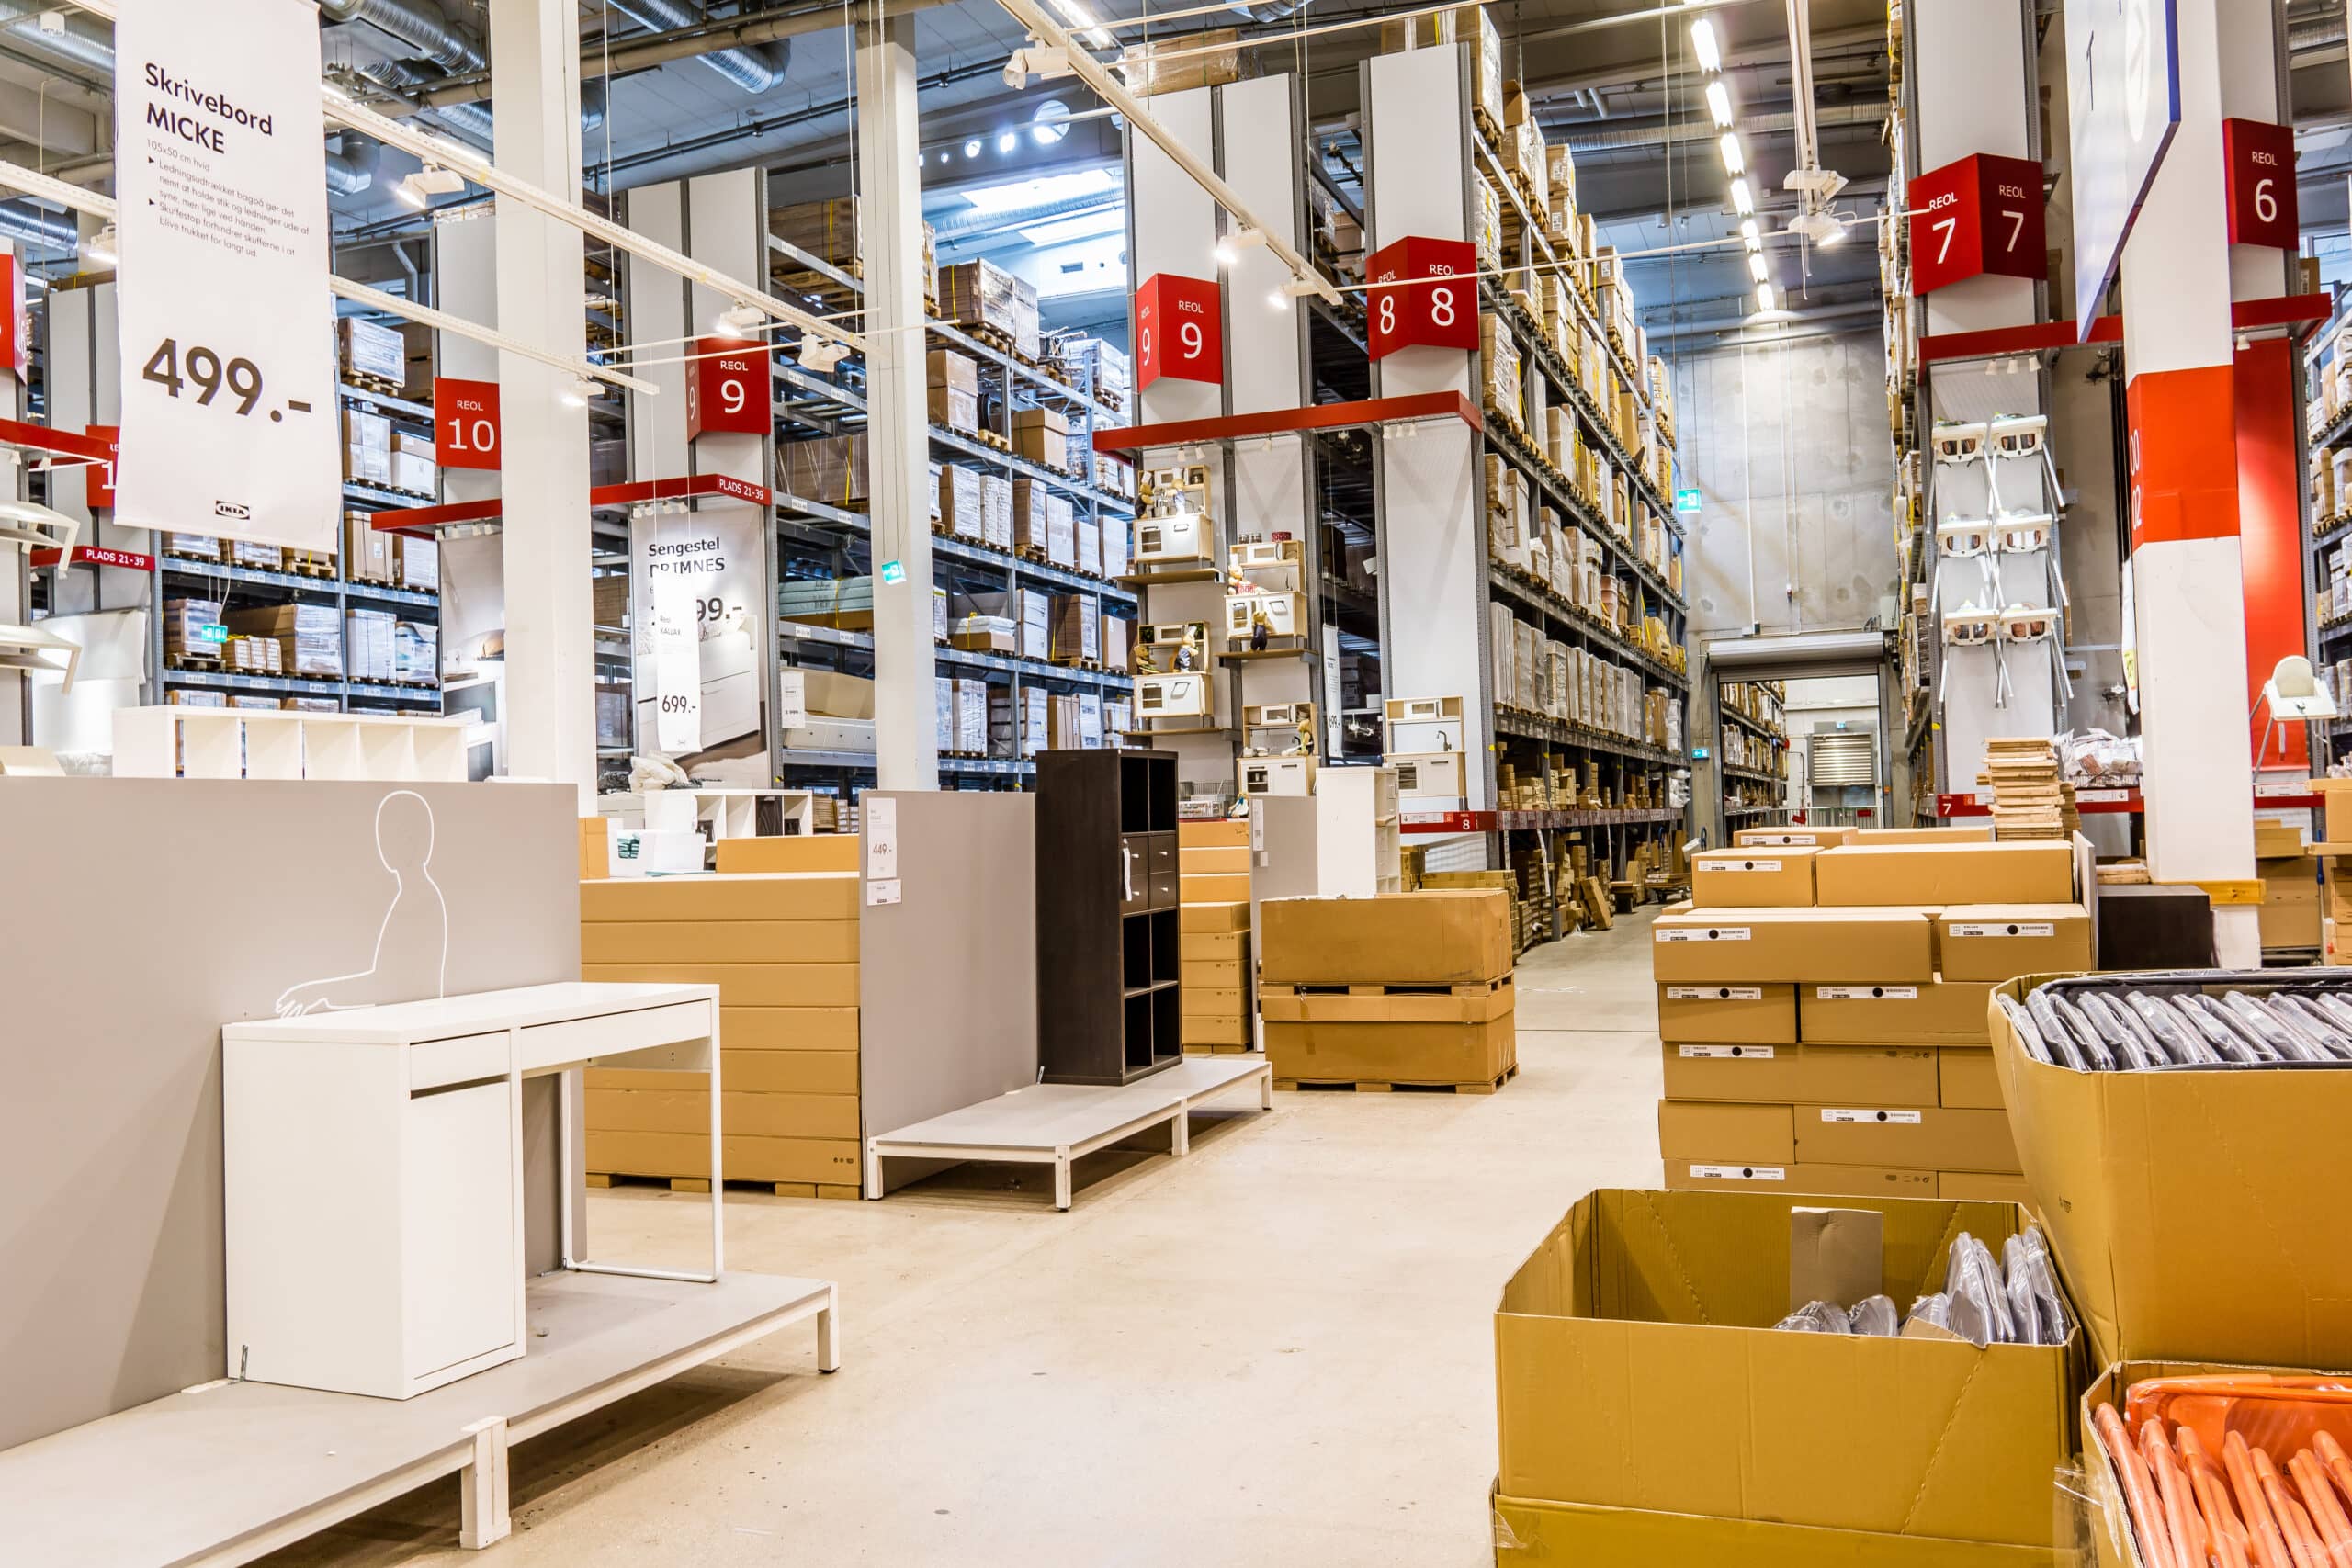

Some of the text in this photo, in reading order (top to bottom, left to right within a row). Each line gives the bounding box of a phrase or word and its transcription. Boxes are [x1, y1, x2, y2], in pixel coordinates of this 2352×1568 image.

[145, 62, 273, 136] Skrivebord
[146, 102, 225, 154] MICKE
[147, 138, 210, 172] 105x50 cm hvid
[2252, 151, 2278, 166] REOL
[159, 175, 179, 189] nemt
[191, 186, 215, 201] holde
[216, 197, 230, 208] stik
[231, 204, 243, 214] og
[243, 205, 281, 226] ledninger
[283, 221, 300, 231] ude
[1929, 191, 1958, 211] REOL
[1998, 184, 2027, 199] REOL
[2255, 178, 2278, 223] 6
[182, 198, 199, 209] men
[201, 205, 217, 217] lige
[219, 212, 233, 222] ved
[281, 208, 295, 218] det
[159, 215, 179, 231] blive
[181, 224, 209, 241] trukket
[1932, 217, 1956, 265] 7
[2002, 210, 2024, 253] 7
[1178, 300, 1204, 314] REOL
[1380, 295, 1396, 335] 8
[1431, 287, 1455, 327] 8
[1142, 327, 1150, 367] 9
[1180, 321, 1203, 359] 9
[720, 360, 749, 371] REOL
[142, 337, 312, 423] 499.-
[457, 400, 484, 412] REOL
[689, 386, 695, 421] 9
[720, 379, 745, 414] 9
[448, 418, 495, 452] 10
[101, 460, 116, 490] 1
[719, 479, 764, 500] PLADS 21-39
[218, 502, 247, 517] IKEA
[86, 549, 145, 567] PLADS 21-39
[648, 536, 720, 557] Sengestel
[662, 695, 696, 714] 699.-
[1942, 803, 1951, 815] 7
[1462, 818, 1470, 830] 8
[873, 843, 892, 855] 449.-
